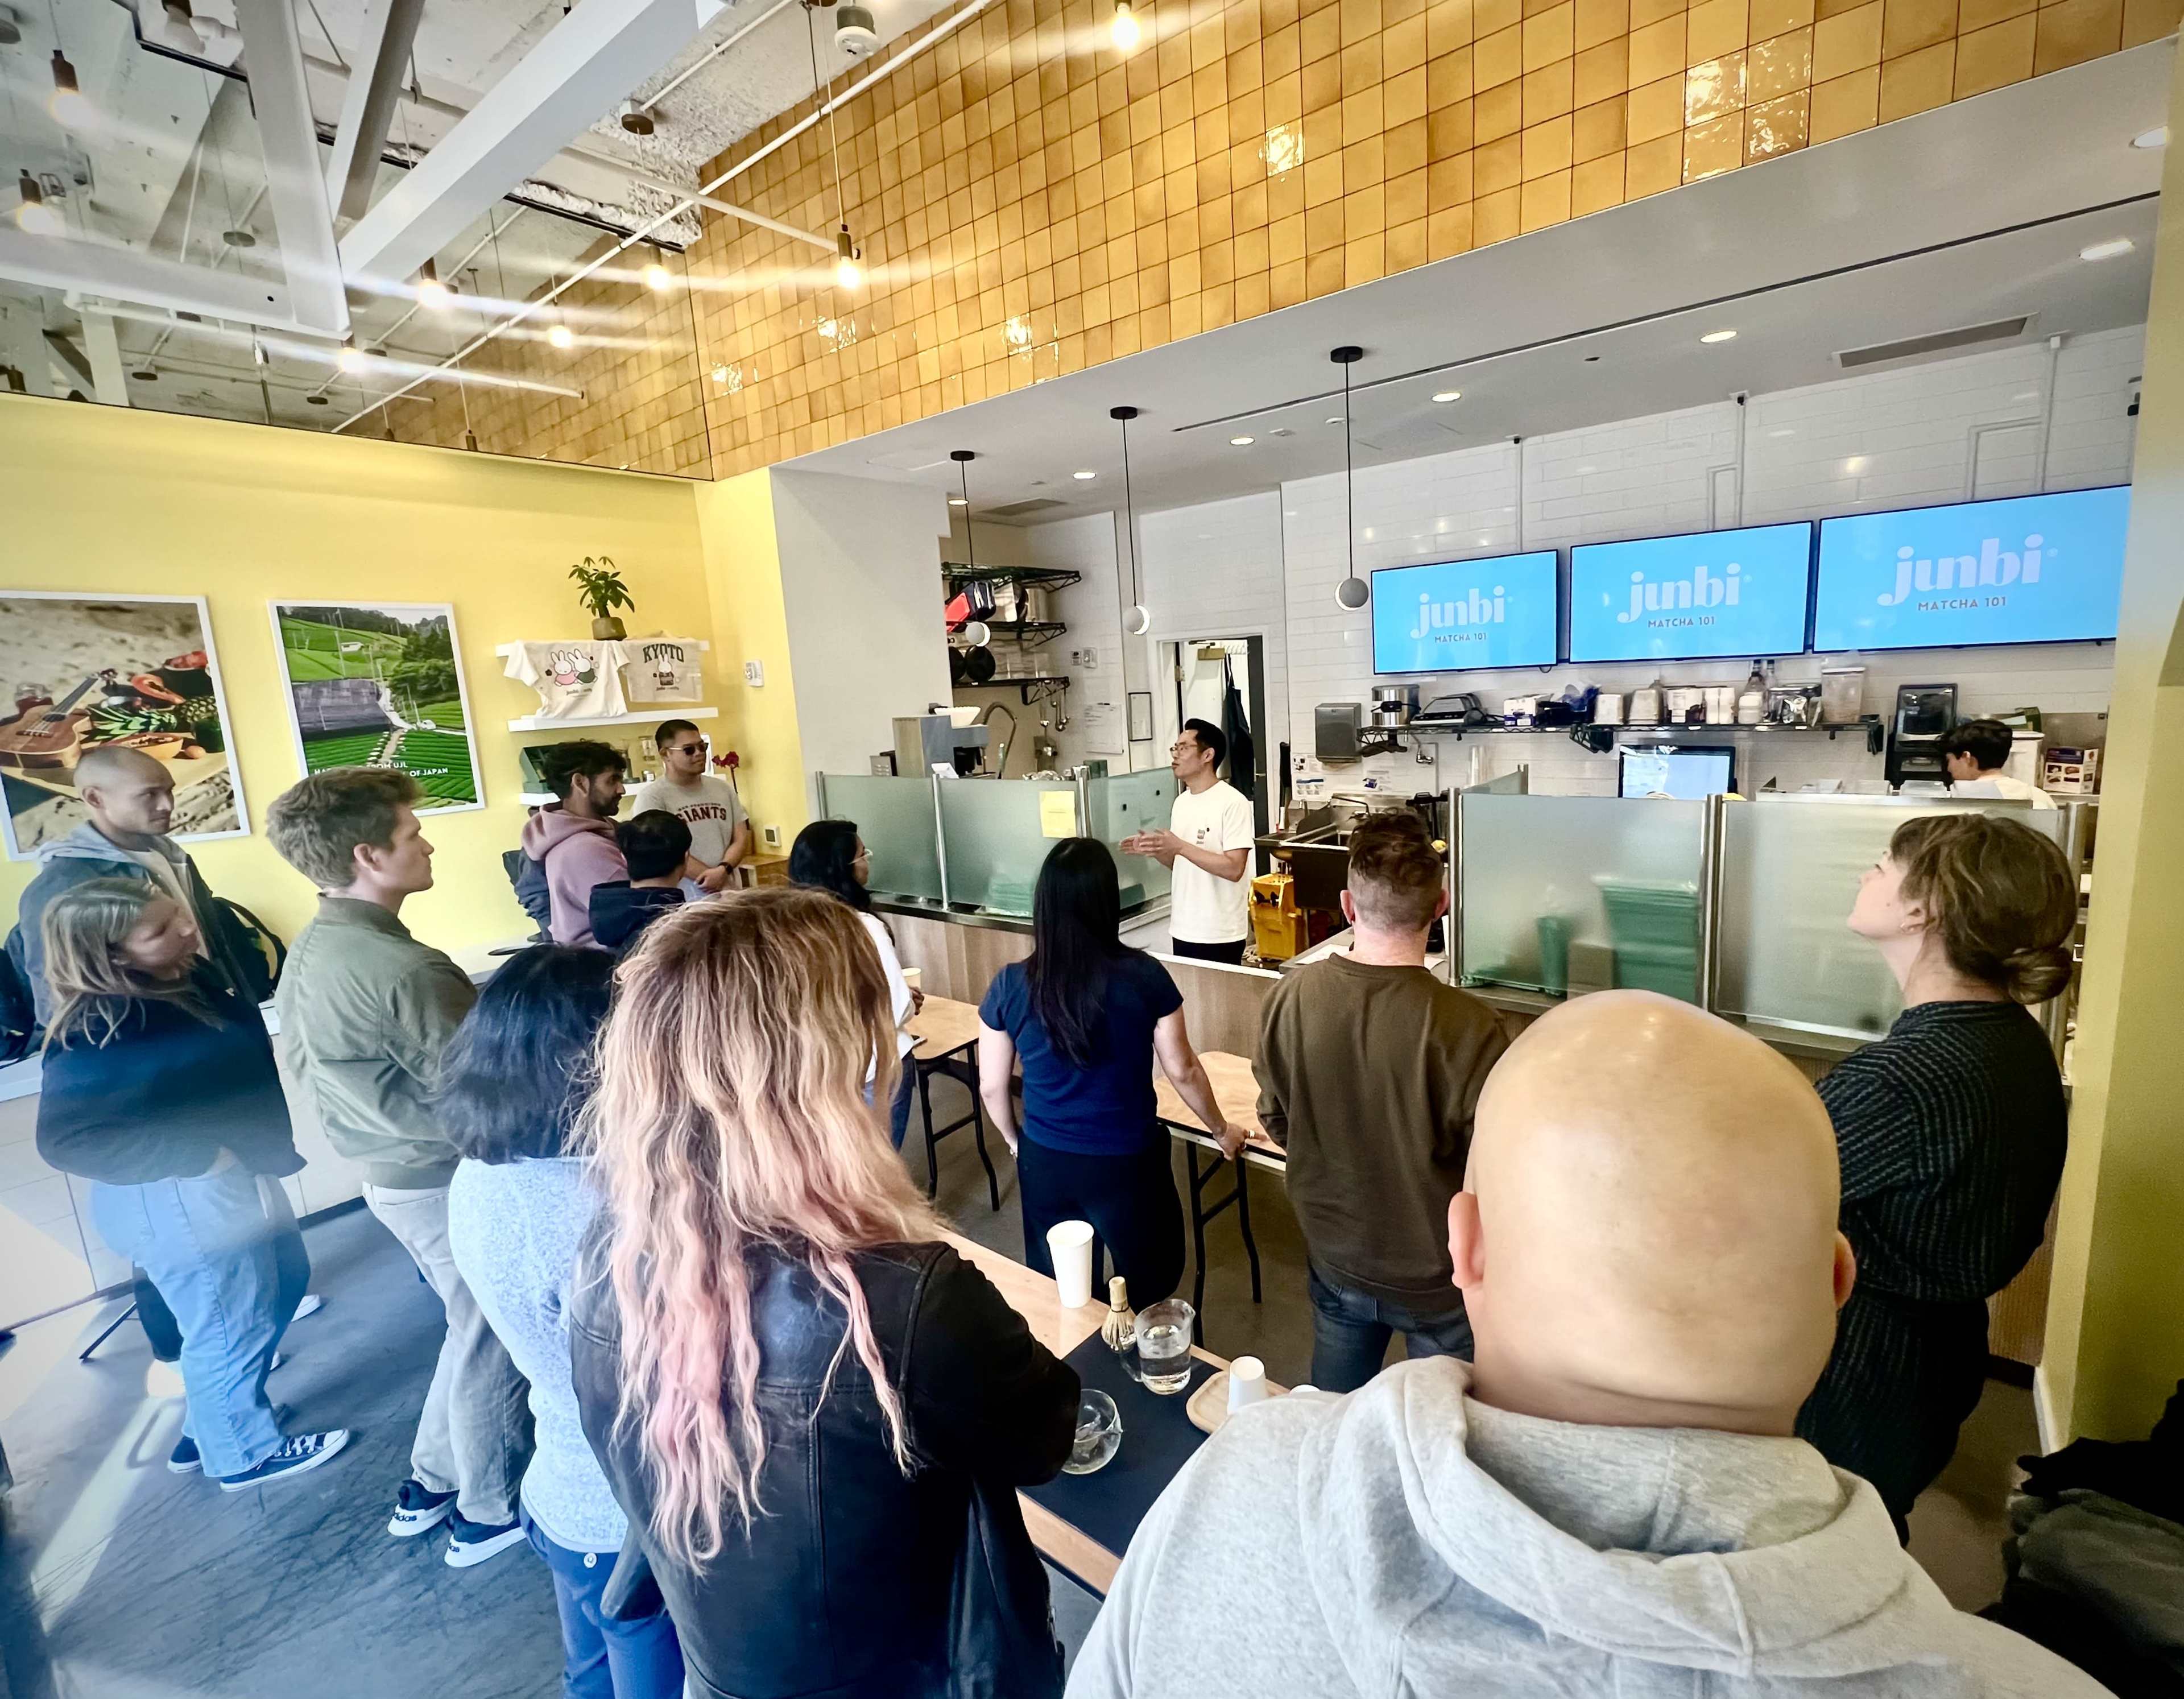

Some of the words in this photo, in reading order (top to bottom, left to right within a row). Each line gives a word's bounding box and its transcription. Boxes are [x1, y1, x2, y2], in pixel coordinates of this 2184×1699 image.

[1876, 533, 2044, 606] junbi
[1616, 562, 1741, 623] junbi
[1410, 585, 1505, 639] junbi
[1918, 598, 1979, 611] MATCHA
[1984, 596, 2007, 607] 101
[1648, 618, 1694, 628] MATCHA
[1699, 616, 1715, 625] 101
[1434, 634, 1470, 643] MATCHA
[642, 643, 684, 663] KYOTO
[423, 767, 448, 776] JAPAN
